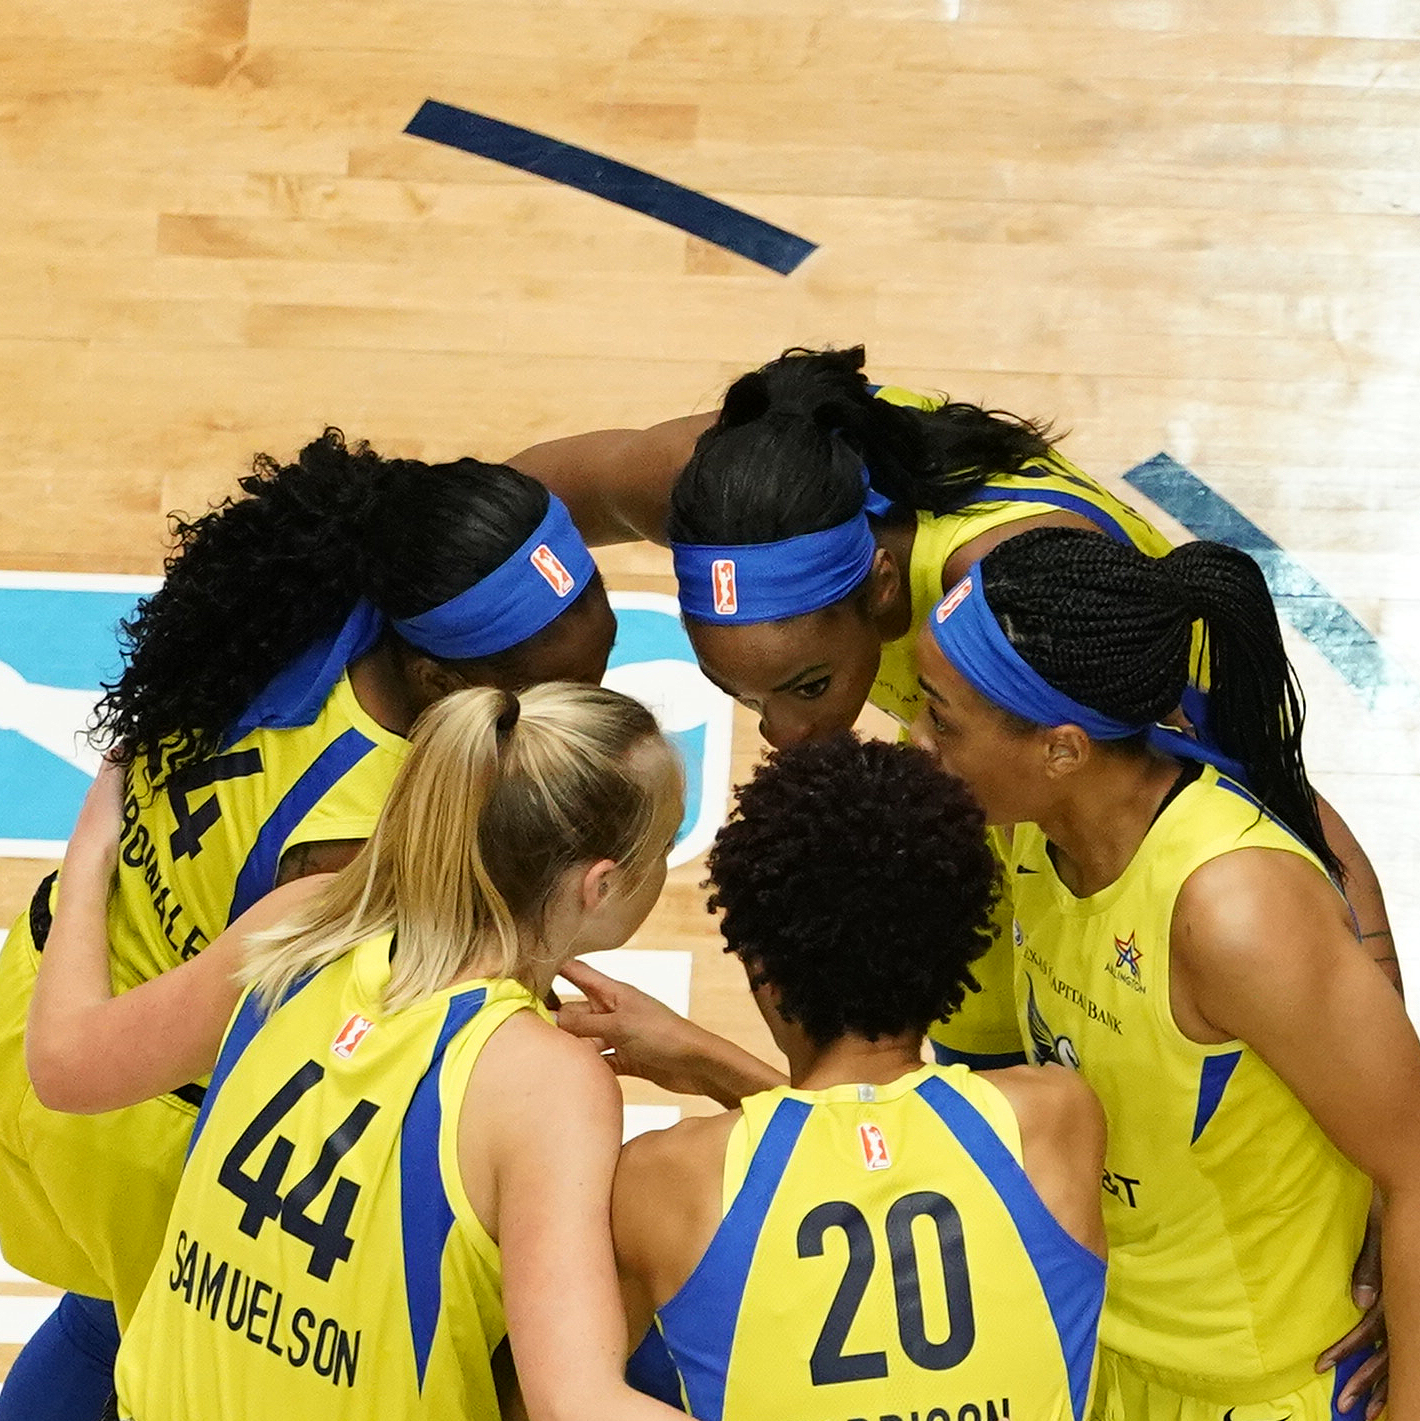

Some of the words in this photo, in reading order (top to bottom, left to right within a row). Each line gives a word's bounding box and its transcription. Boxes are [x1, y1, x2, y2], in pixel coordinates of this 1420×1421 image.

[1087, 999, 1123, 1036] BANK
[217, 1059, 382, 1283] 44
[169, 1230, 362, 1389] SAMUELSON
[796, 1190, 976, 1387] 20
